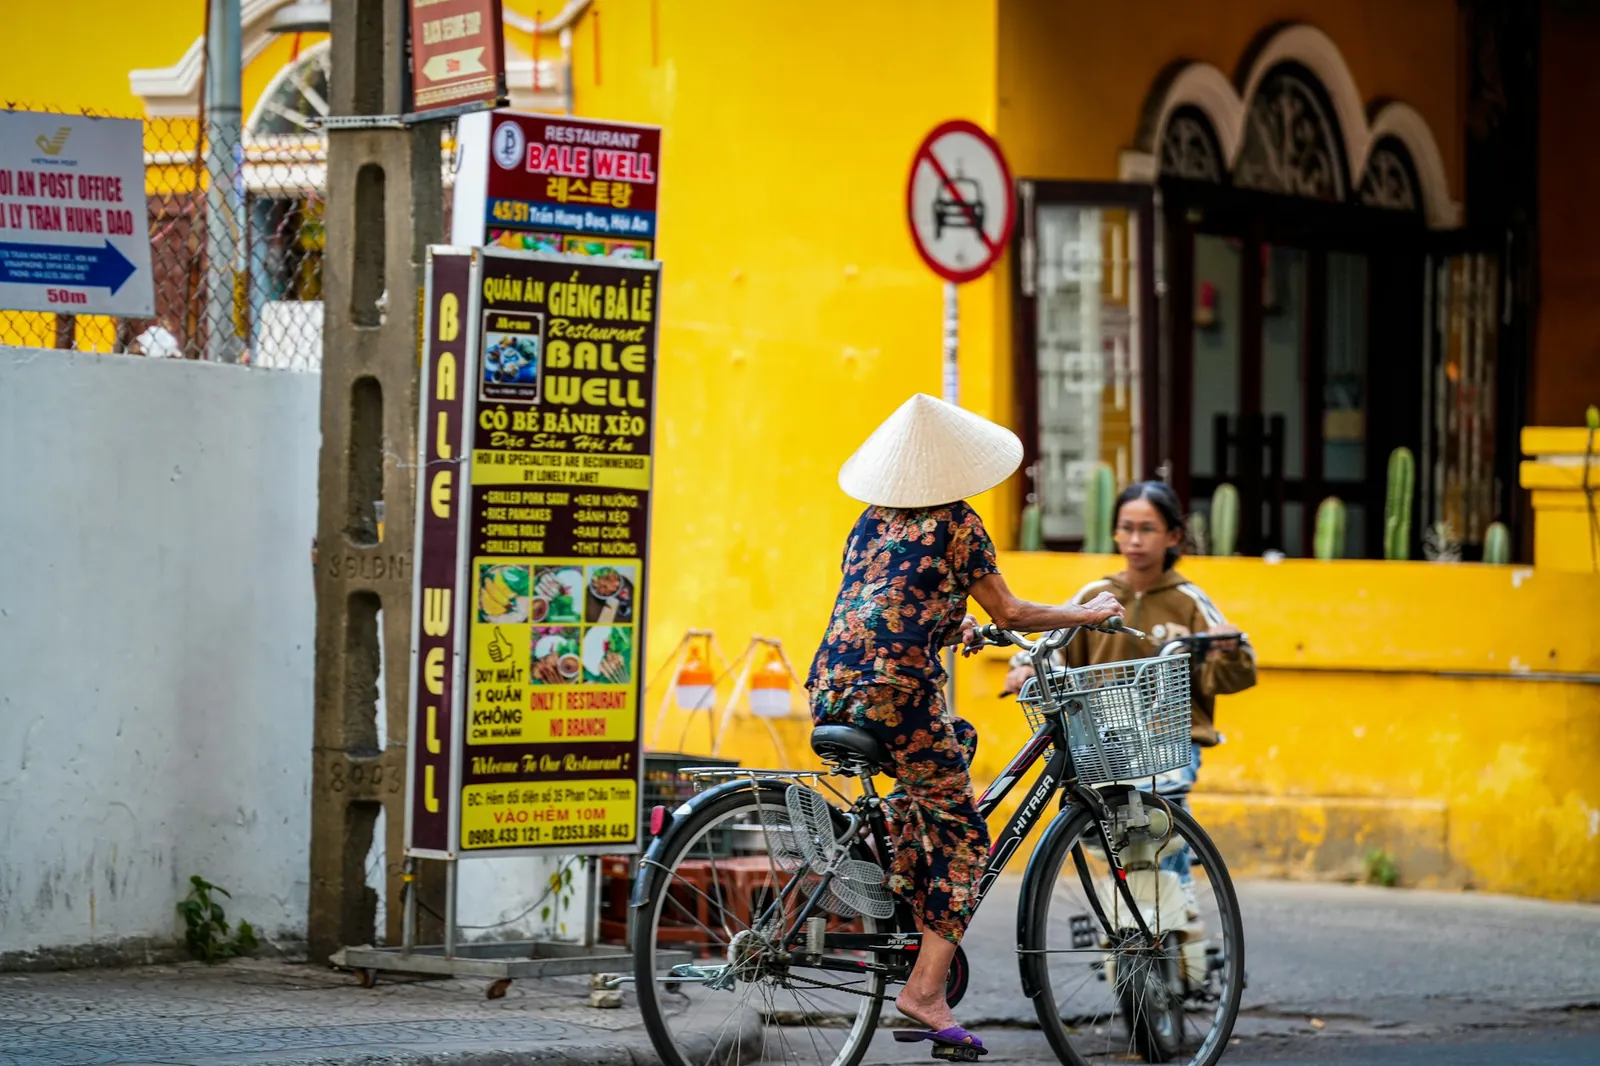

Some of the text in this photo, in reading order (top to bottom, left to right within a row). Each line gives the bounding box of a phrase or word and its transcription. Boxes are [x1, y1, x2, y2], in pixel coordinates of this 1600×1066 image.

[544, 125, 641, 149] RESTAURANT
[526, 141, 655, 184] BALE WELL
[0, 169, 123, 202] OI AN POST OFFICE
[546, 177, 633, 208] 레스토랑
[9, 203, 22, 229] LY
[27, 204, 62, 232] TRAN
[65, 206, 103, 234] HUNG
[106, 208, 134, 236] DAO
[631, 216, 649, 233] An
[47, 288, 87, 304] 50m
[484, 274, 522, 304] QUÁN
[548, 270, 602, 320] GIẾNG
[604, 278, 629, 321] BÁ
[496, 317, 531, 330] Menu
[548, 318, 646, 342] Restaurant
[546, 340, 646, 373] BALE
[544, 375, 646, 408] WELL
[431, 292, 459, 518] BALE
[479, 404, 646, 436] CÔ BÉ BÁNH XÈO
[608, 436, 634, 452] An
[476, 452, 645, 470] HOI AN SPECIALITIES ARE RECOMMENDED
[523, 469, 599, 483] BY LONELY PLANET
[475, 669, 494, 684] DUY
[423, 588, 451, 813] WELL
[476, 685, 522, 703] 1 QUÁN
[530, 691, 627, 711] ONLY 1 RESTAURANT
[473, 706, 522, 726] KHÔNG
[550, 718, 607, 737] NO BRANCH
[471, 756, 519, 775] Welcome
[521, 754, 538, 773] To
[539, 754, 561, 772] Our
[565, 788, 585, 802] Phan
[1013, 774, 1055, 836] HITASA
[493, 808, 529, 824] VÀO
[577, 808, 606, 820] 10M
[522, 826, 540, 842] 121
[610, 823, 629, 838] 443
